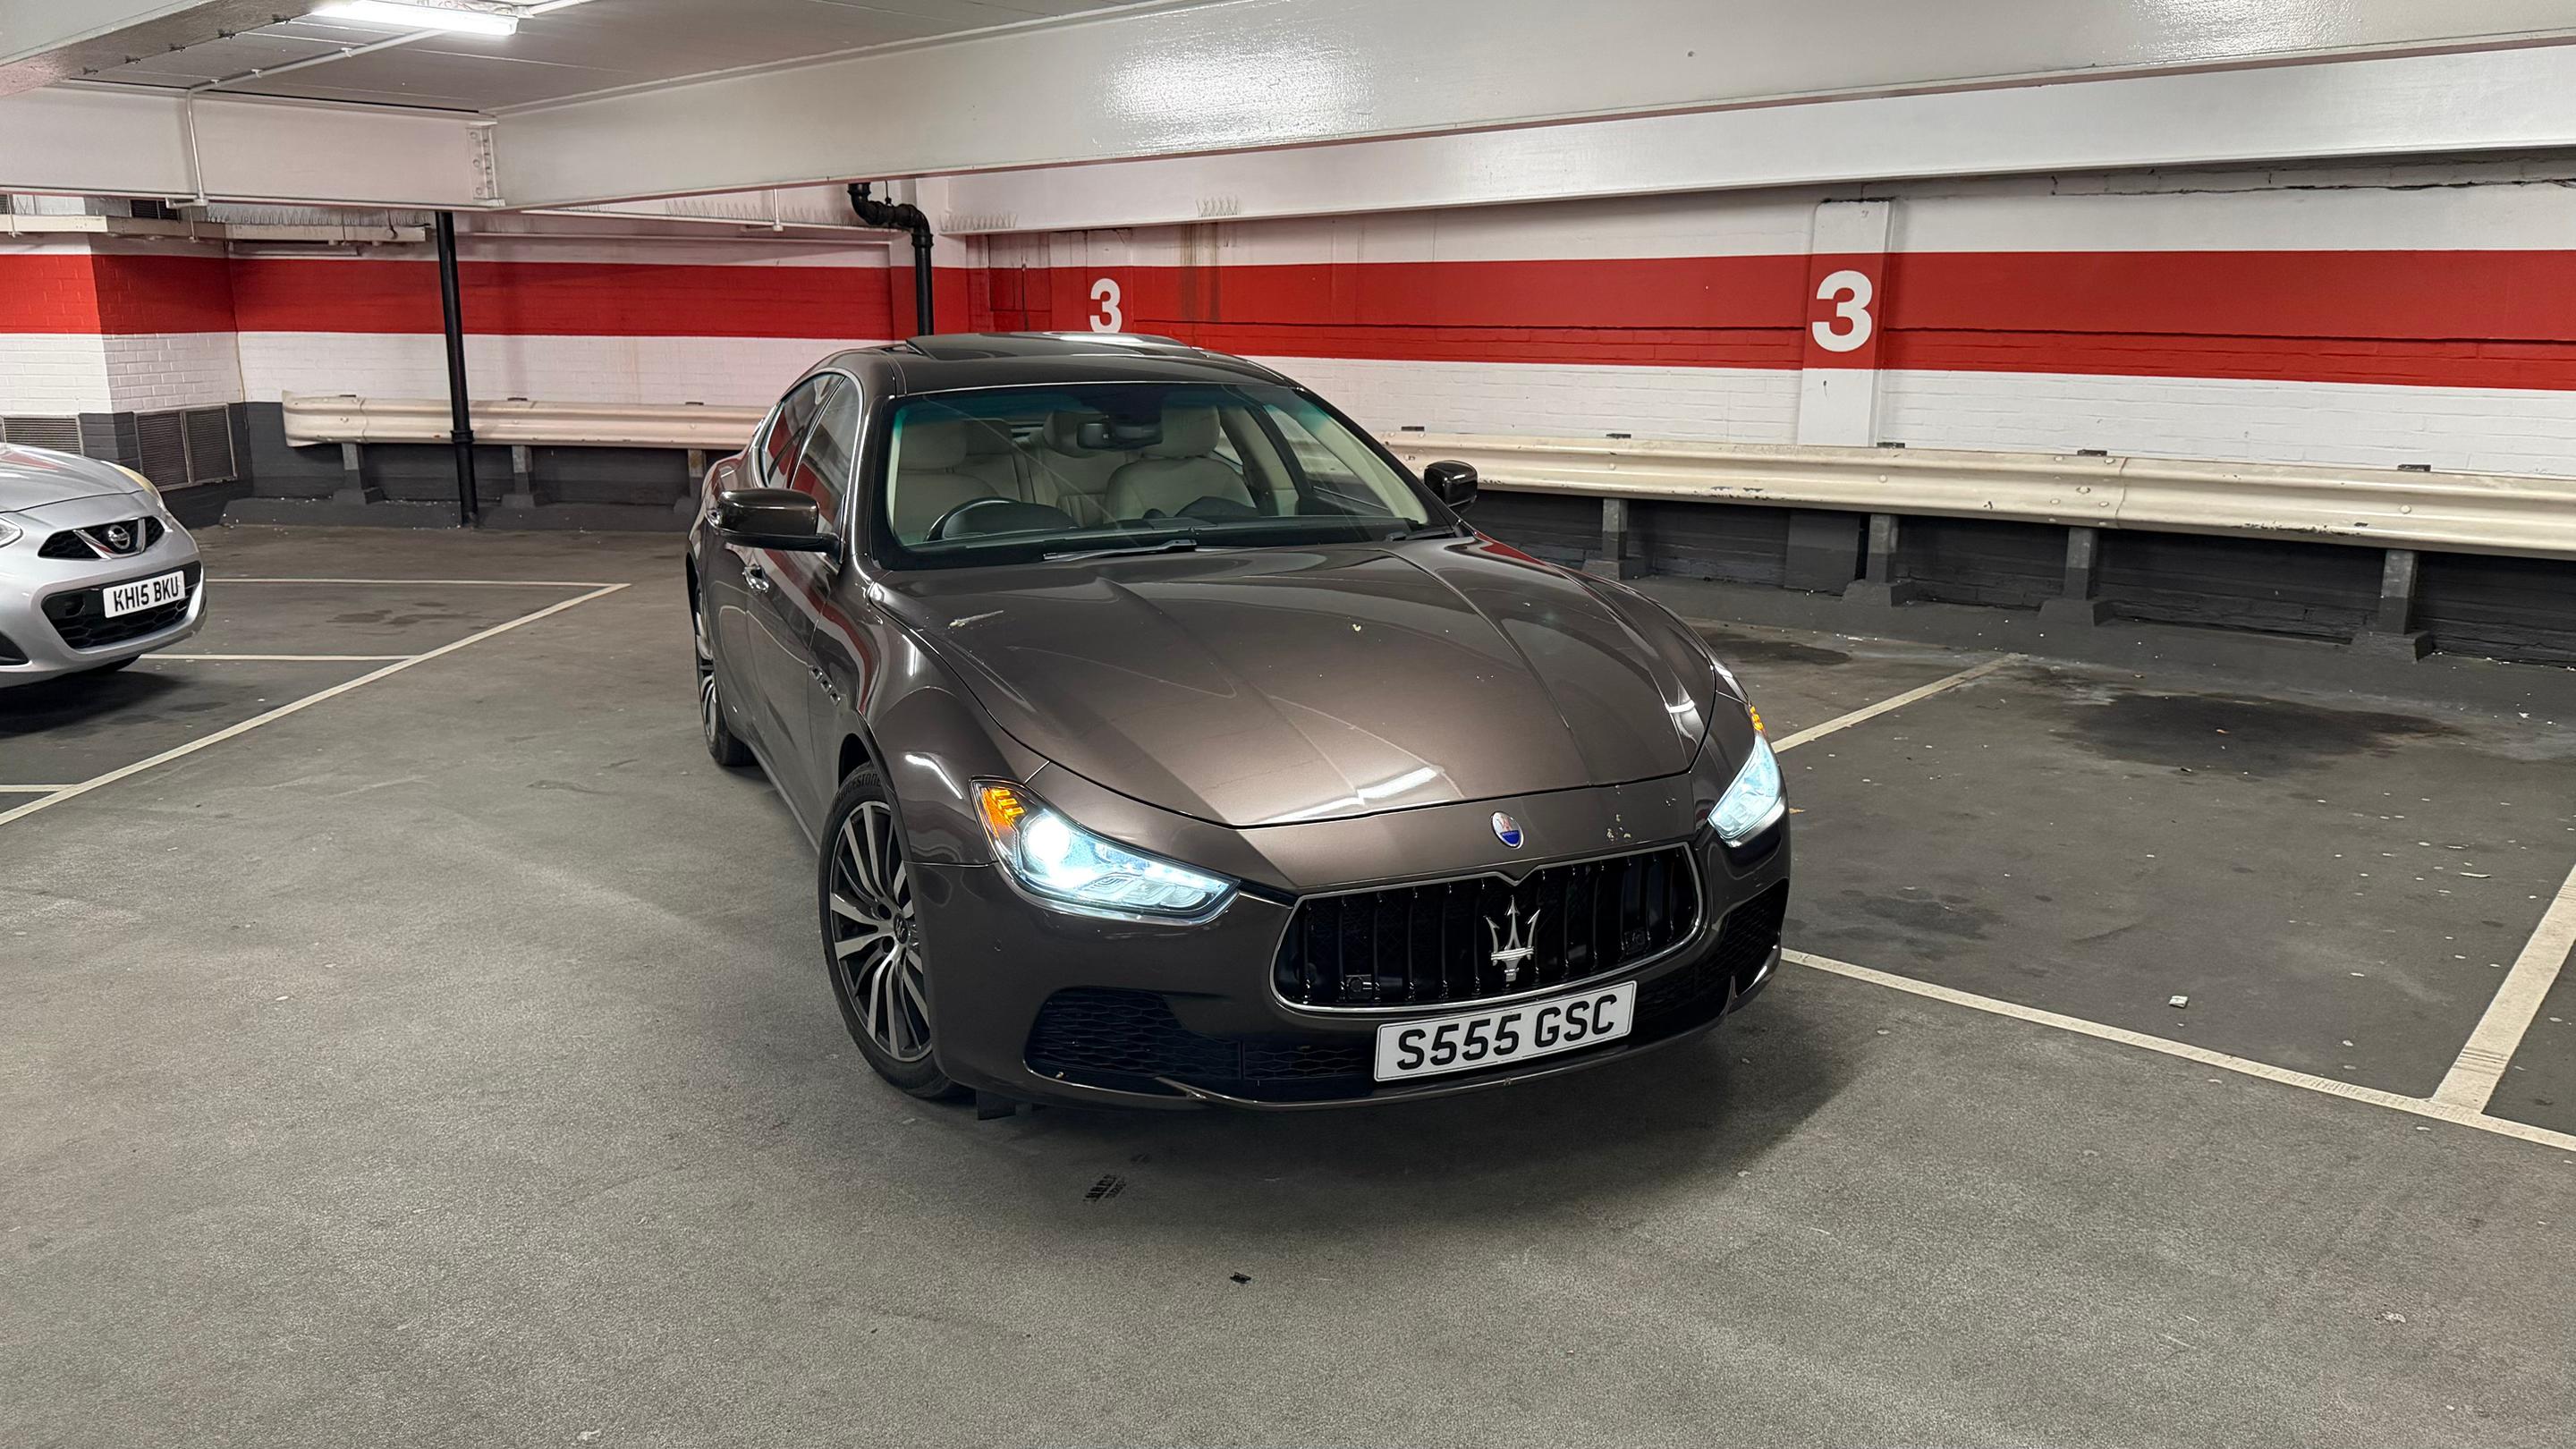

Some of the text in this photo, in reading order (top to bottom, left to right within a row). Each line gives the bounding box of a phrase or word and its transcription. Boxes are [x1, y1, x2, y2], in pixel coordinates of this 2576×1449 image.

[1089, 277, 1123, 333] 3
[1812, 270, 1873, 352] 3
[114, 575, 179, 612] KH15 BKU
[1397, 994, 1618, 1071] S555 GSC
